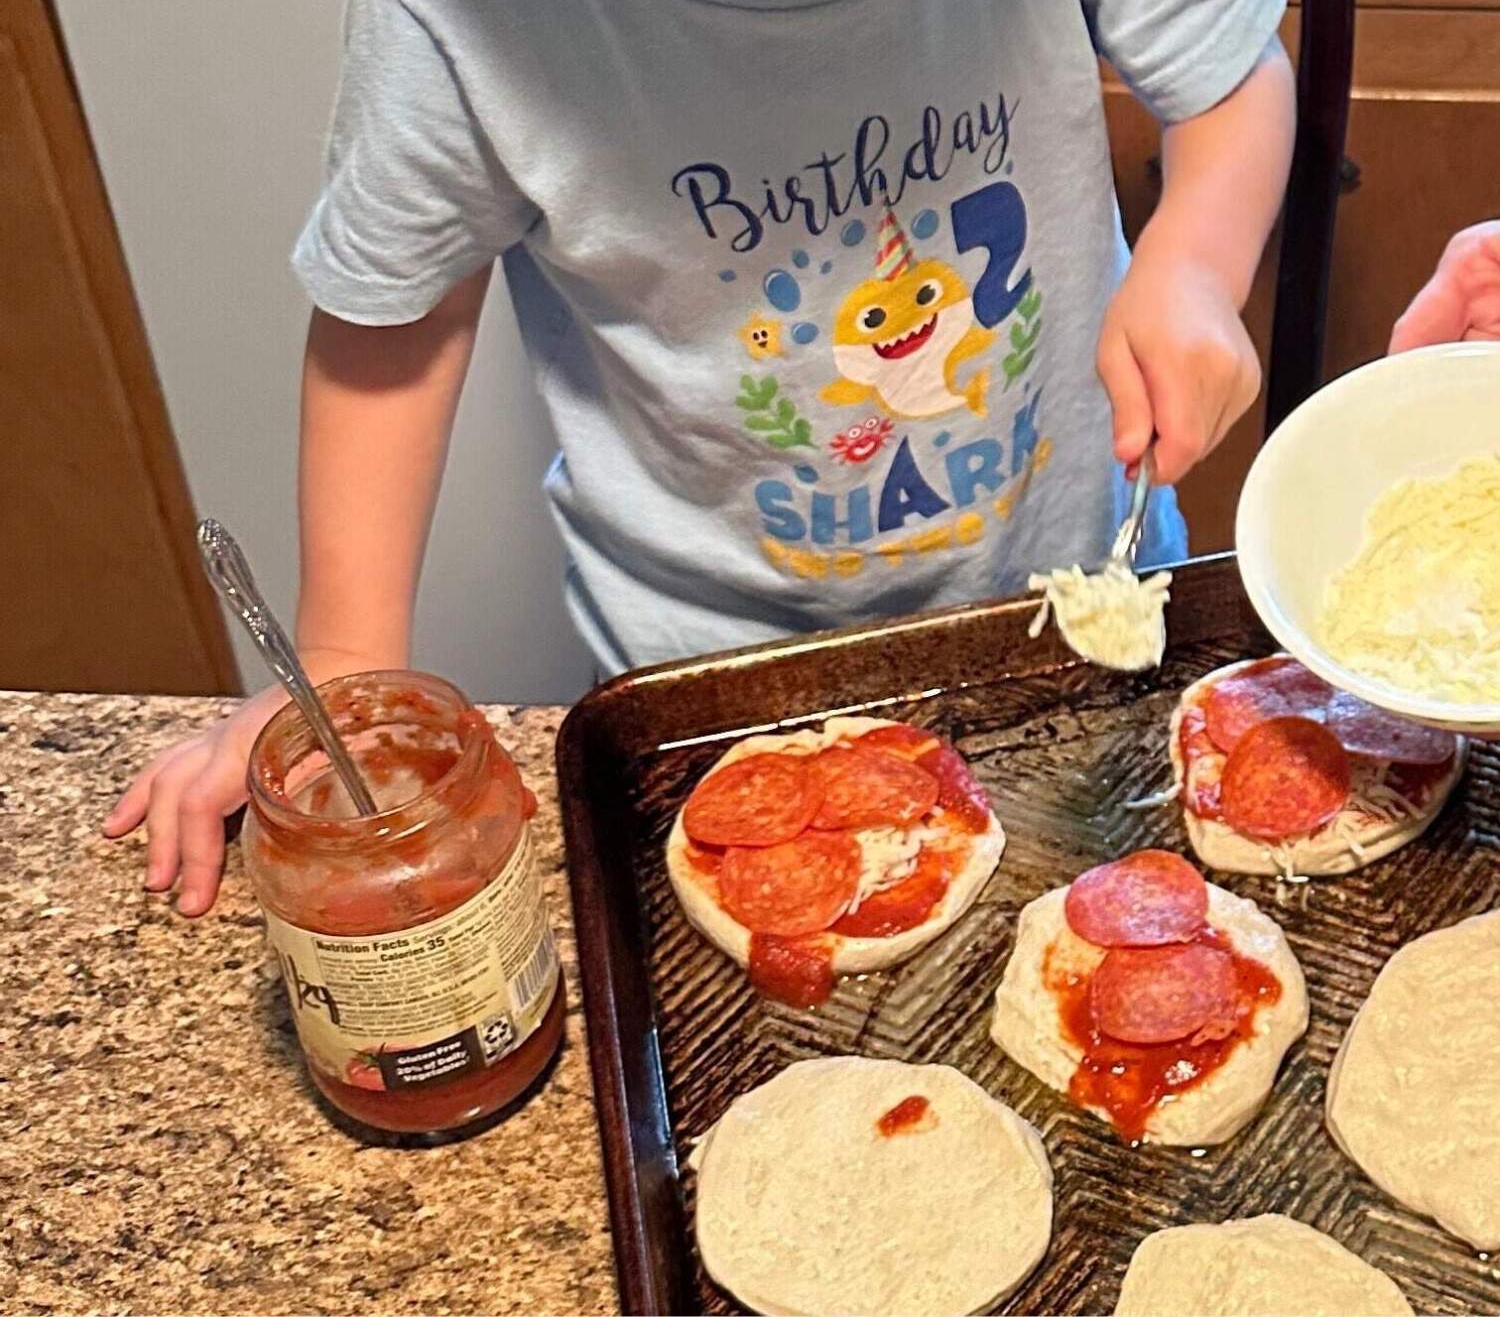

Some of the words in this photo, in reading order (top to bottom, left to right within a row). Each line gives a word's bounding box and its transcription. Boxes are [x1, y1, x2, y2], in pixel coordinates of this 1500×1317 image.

[671, 92, 1020, 252] Birthday
[950, 181, 1031, 329] 2
[317, 940, 370, 954] Nutrition
[373, 938, 410, 952] Facts
[380, 946, 425, 962] Calories
[427, 935, 446, 951] 35
